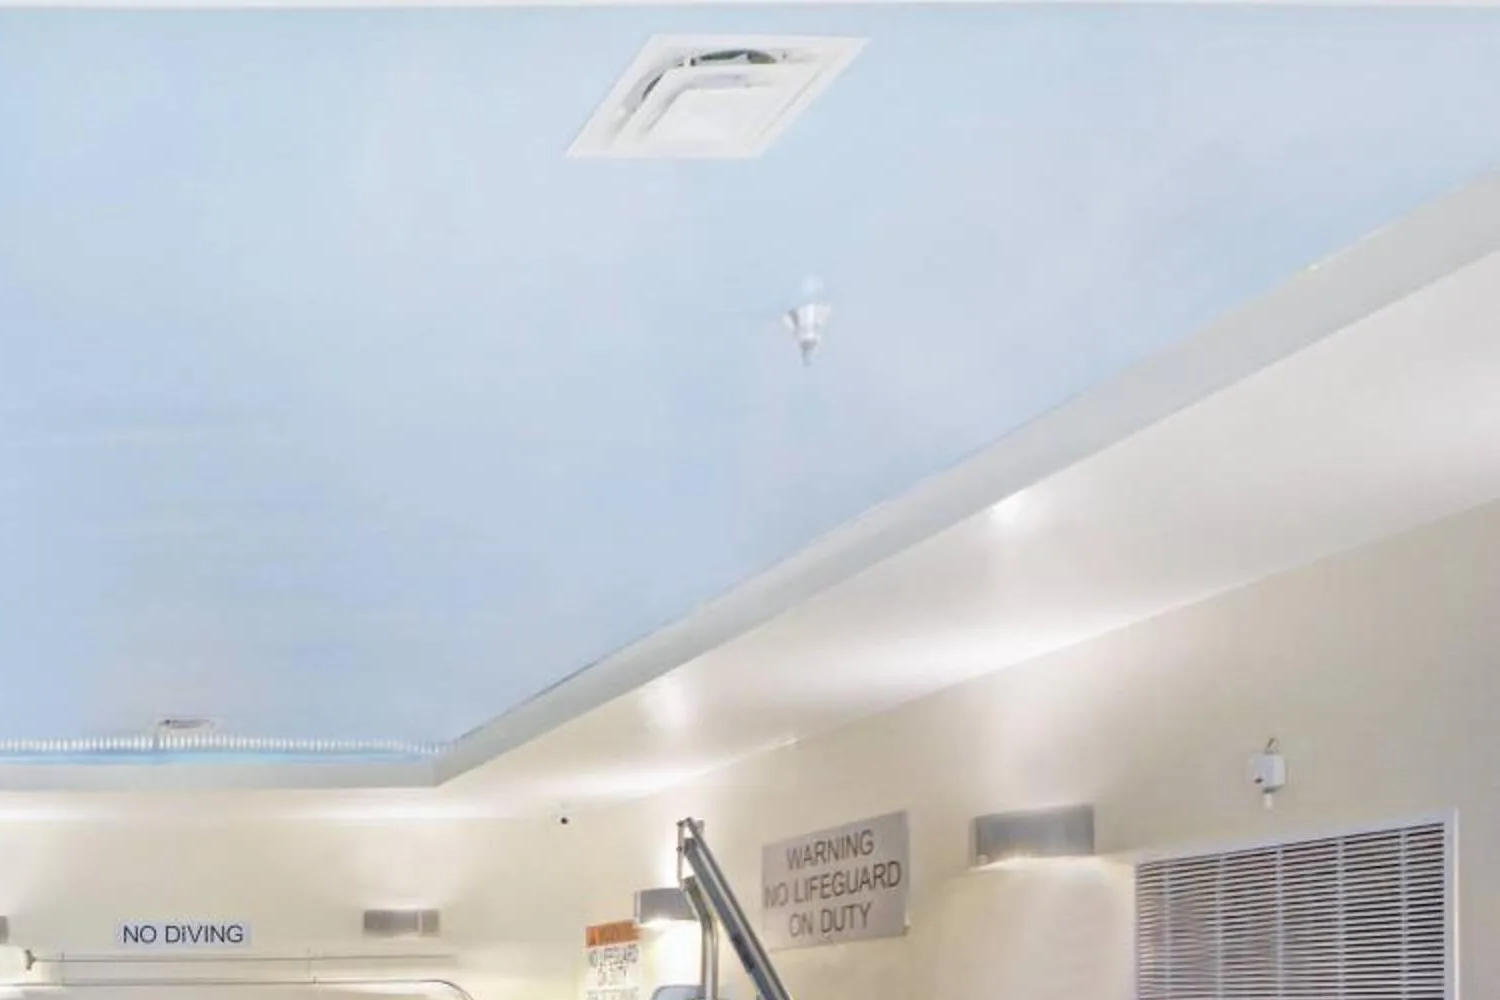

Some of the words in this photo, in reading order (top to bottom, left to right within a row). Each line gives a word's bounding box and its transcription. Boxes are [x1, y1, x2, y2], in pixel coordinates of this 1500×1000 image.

[787, 829, 875, 871] WARNING
[764, 881, 789, 910] NO
[794, 860, 902, 903] LIFEGUARD
[123, 925, 157, 944] NO
[165, 925, 244, 944] DIVING
[789, 911, 814, 938] ON
[820, 902, 871, 934] DUTY
